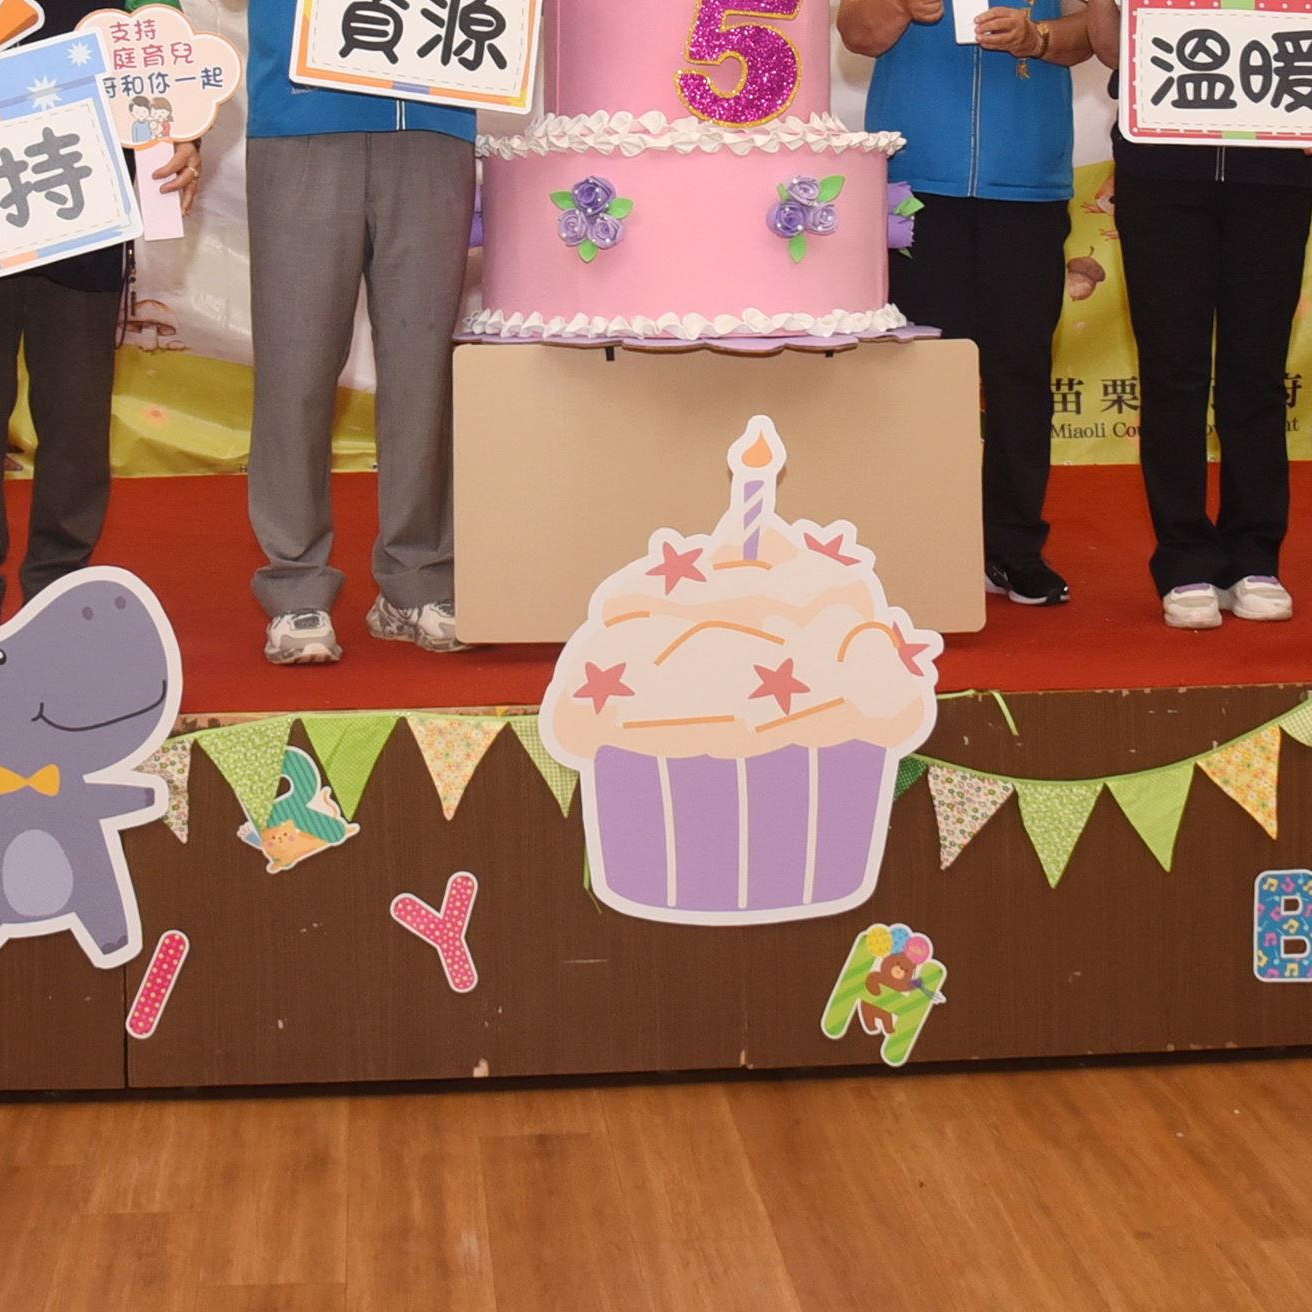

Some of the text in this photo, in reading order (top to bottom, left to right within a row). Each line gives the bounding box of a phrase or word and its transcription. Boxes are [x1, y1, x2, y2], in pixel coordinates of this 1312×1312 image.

[109, 19, 157, 44] 支持
[1051, 423, 1106, 439] Miaoli
[390, 872, 478, 992] Y
